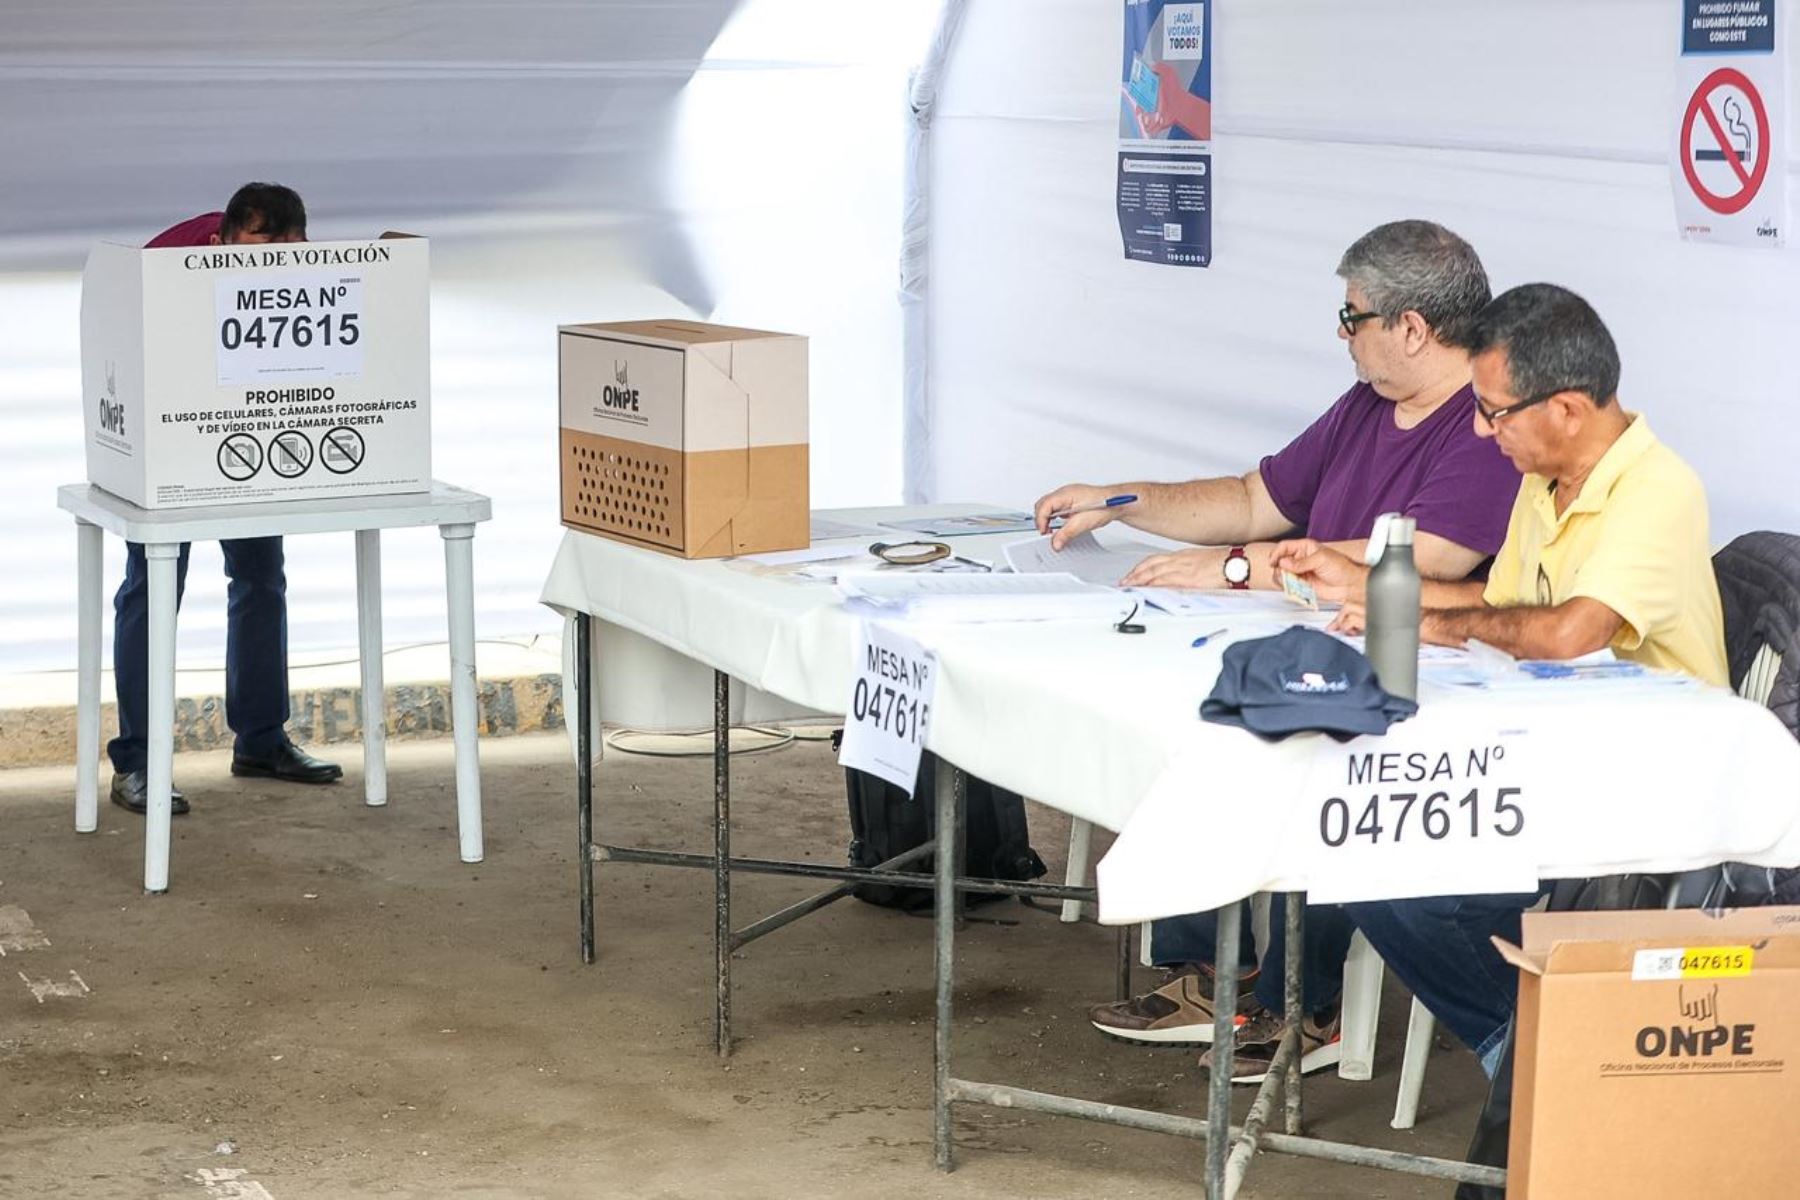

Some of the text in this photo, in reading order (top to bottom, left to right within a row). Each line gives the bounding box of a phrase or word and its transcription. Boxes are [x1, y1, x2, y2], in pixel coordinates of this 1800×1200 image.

[1733, 1, 1760, 12] FUMAR
[1730, 13, 1768, 28] PÚBLICOS
[1169, 37, 1199, 50] TODOS!
[184, 243, 390, 270] CABINA DE VOTACIÓN
[236, 286, 347, 310] MESA Nº
[221, 313, 360, 350] 047615
[246, 387, 335, 405] PROHIBIDO
[603, 385, 639, 412] ONPE
[100, 397, 125, 436] ONPE
[162, 399, 417, 423] EL USO DE CELULARES, CÁMARAS FOTOGRÁFICAS
[197, 415, 384, 434] Y DE VÍDEO EN LA CÁMARA SECRETA
[867, 644, 909, 686] MESA
[1348, 745, 1505, 785] MESA Nº
[1319, 787, 1525, 847] 047615
[1679, 954, 1744, 970] 047615
[1635, 1023, 1755, 1057] ONPE
